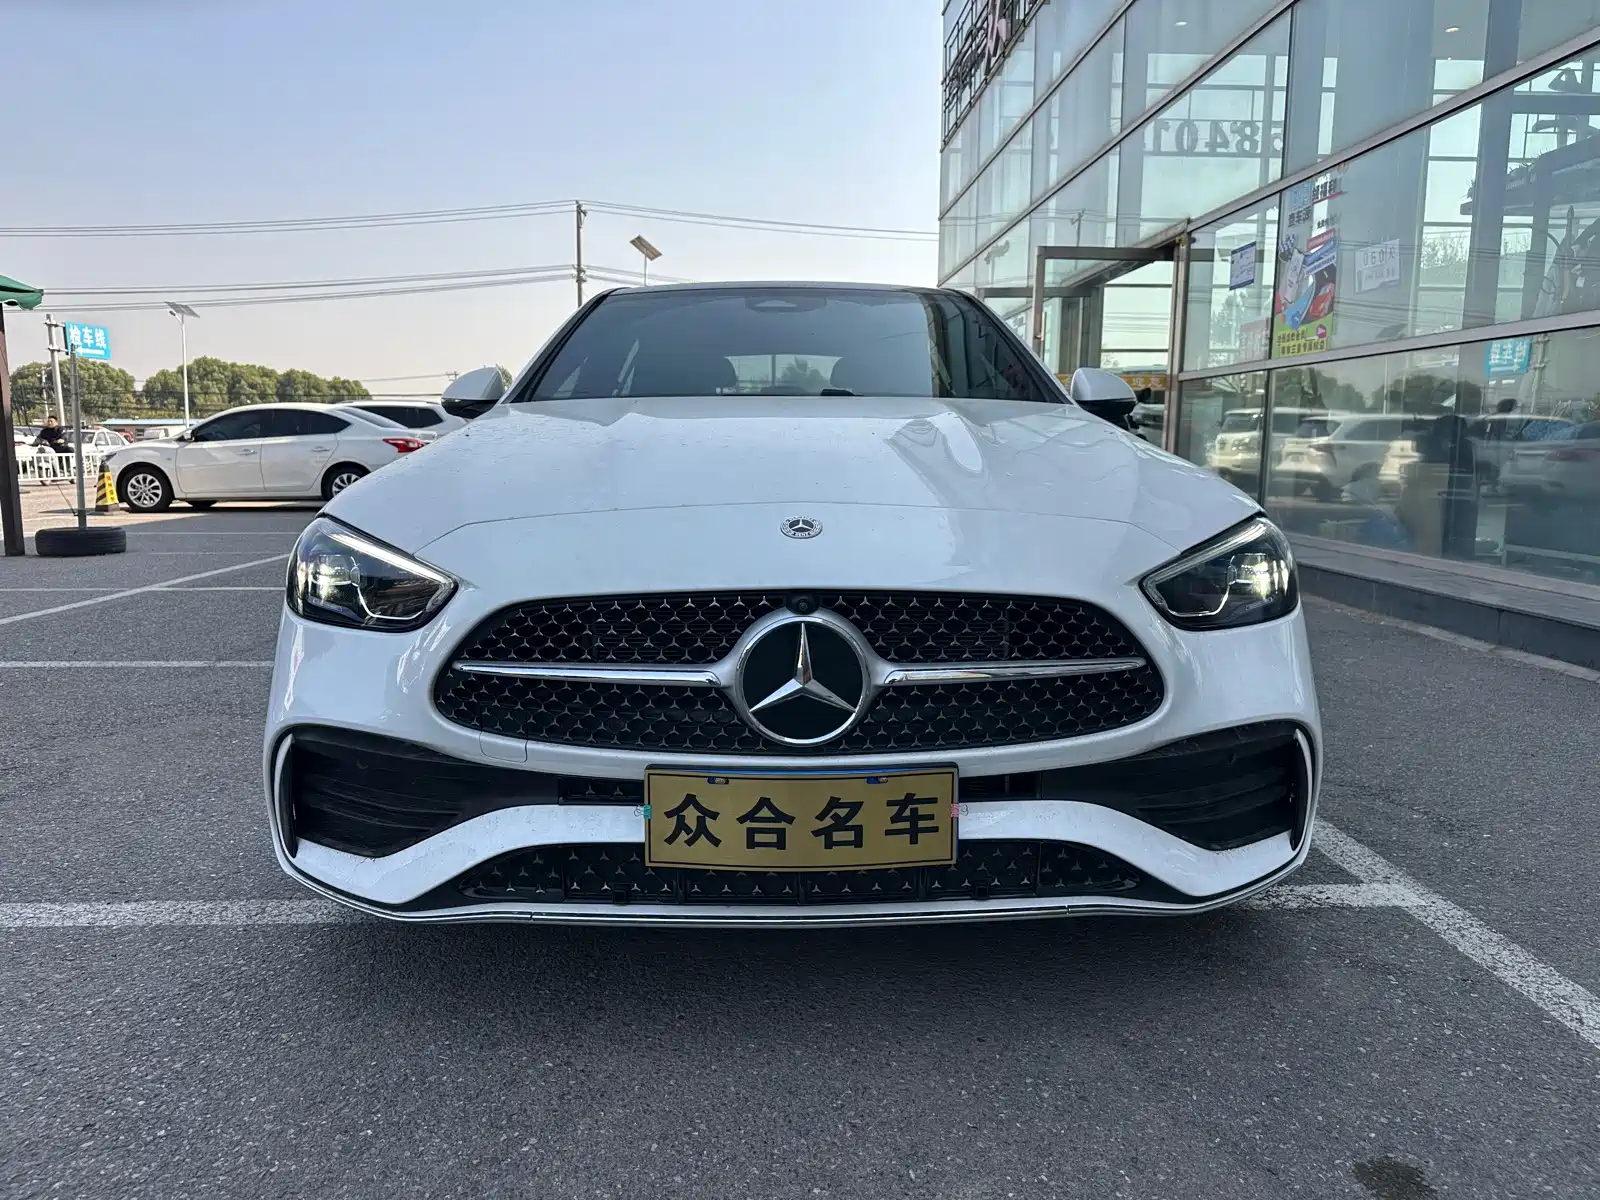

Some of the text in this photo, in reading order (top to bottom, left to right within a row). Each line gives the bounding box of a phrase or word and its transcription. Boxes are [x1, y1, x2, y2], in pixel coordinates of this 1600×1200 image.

[69, 324, 106, 348] 检车线
[664, 793, 940, 850] 众合名车
